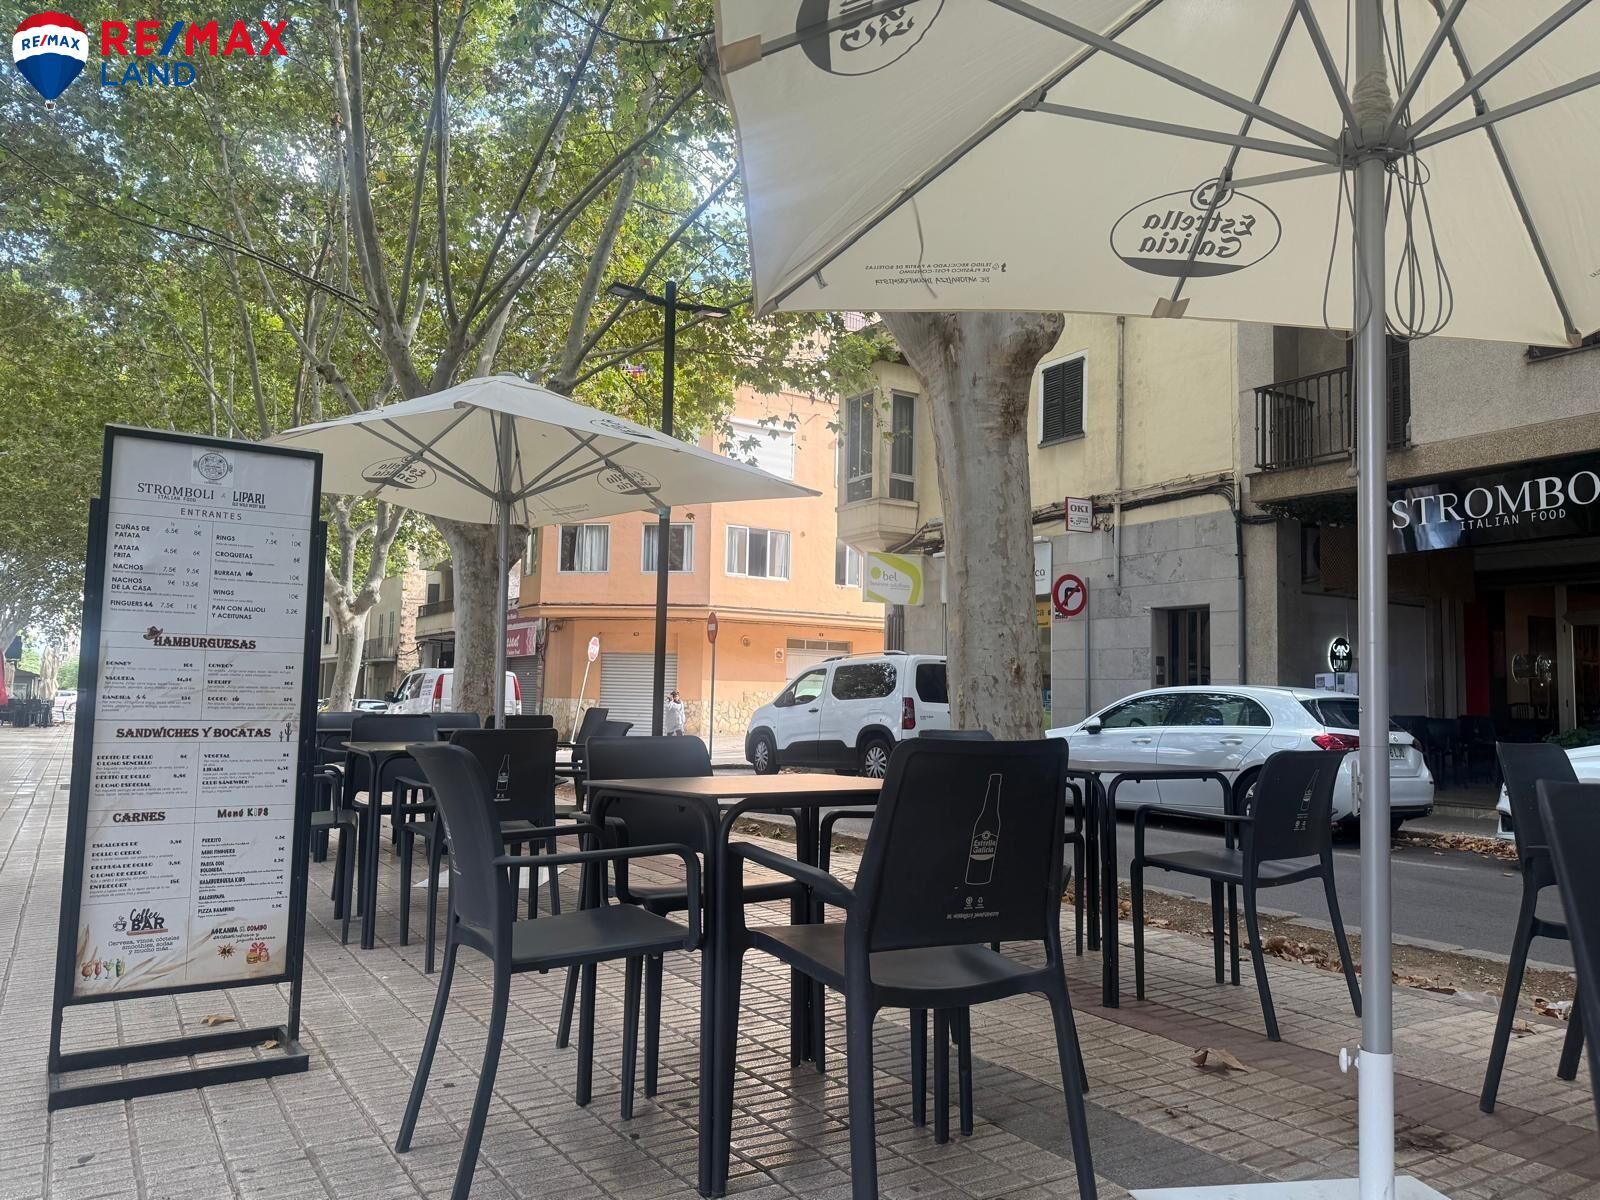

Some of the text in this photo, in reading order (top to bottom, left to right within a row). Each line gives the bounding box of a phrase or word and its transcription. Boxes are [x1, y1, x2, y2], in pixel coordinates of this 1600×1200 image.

[137, 482, 265, 504] STROMBOLI LIPARI
[1392, 470, 1600, 529] STROMBO
[181, 508, 242, 520] ENTRANTES
[1070, 504, 1088, 513] OKI
[1460, 509, 1566, 530] ITALIAN FOOD
[115, 523, 139, 531] CUÑAS
[215, 551, 253, 559] CROQUETAS
[883, 571, 896, 581] bel
[153, 636, 256, 649] HAMBURGUESAS
[202, 727, 212, 737] Y
[213, 728, 271, 737] BOCATAS
[113, 812, 166, 823] CARNES
[217, 808, 244, 818] Menú
[130, 908, 160, 921] Coffee
[132, 917, 165, 931] BAR
